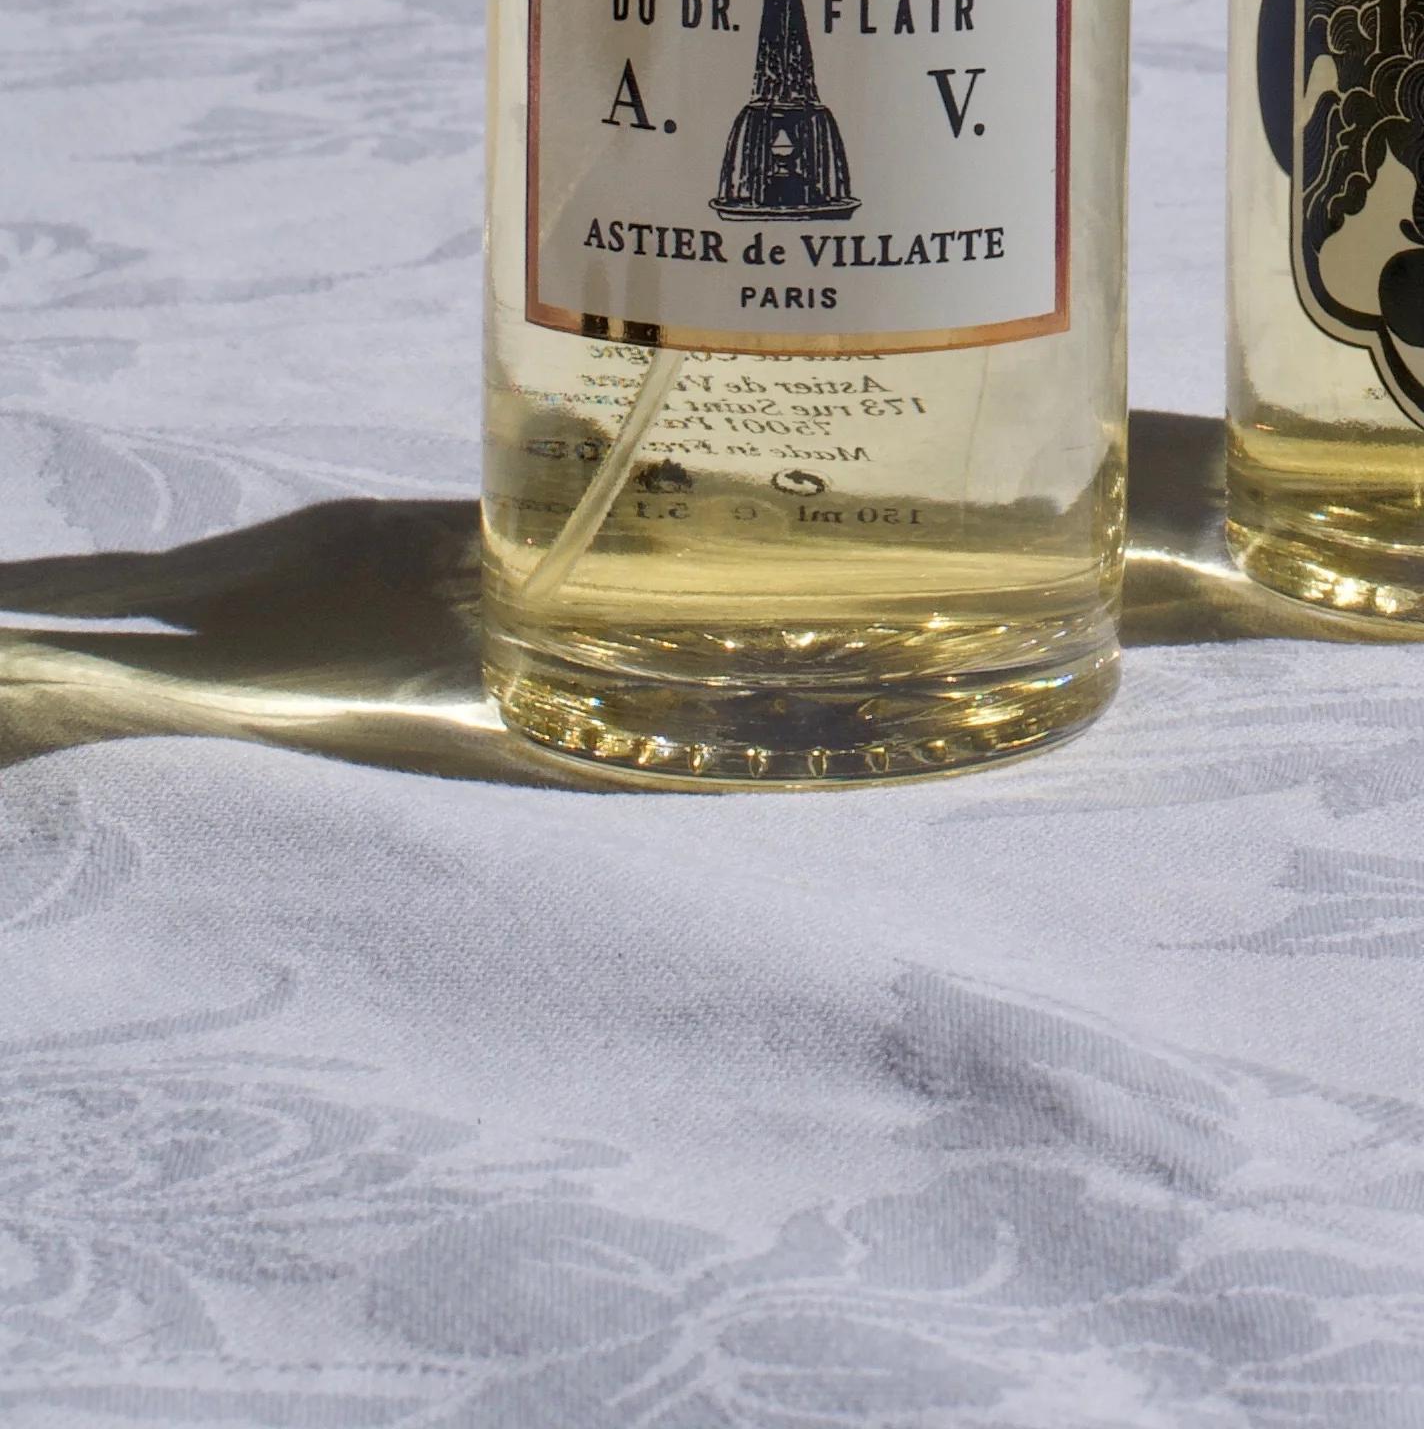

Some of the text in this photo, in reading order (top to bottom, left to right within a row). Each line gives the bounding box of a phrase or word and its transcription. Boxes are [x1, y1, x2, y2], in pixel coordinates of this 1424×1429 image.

[601, 57, 986, 139] A. V.
[583, 218, 1005, 268] ASTIER de VILLATTE
[740, 286, 837, 309] PARIS
